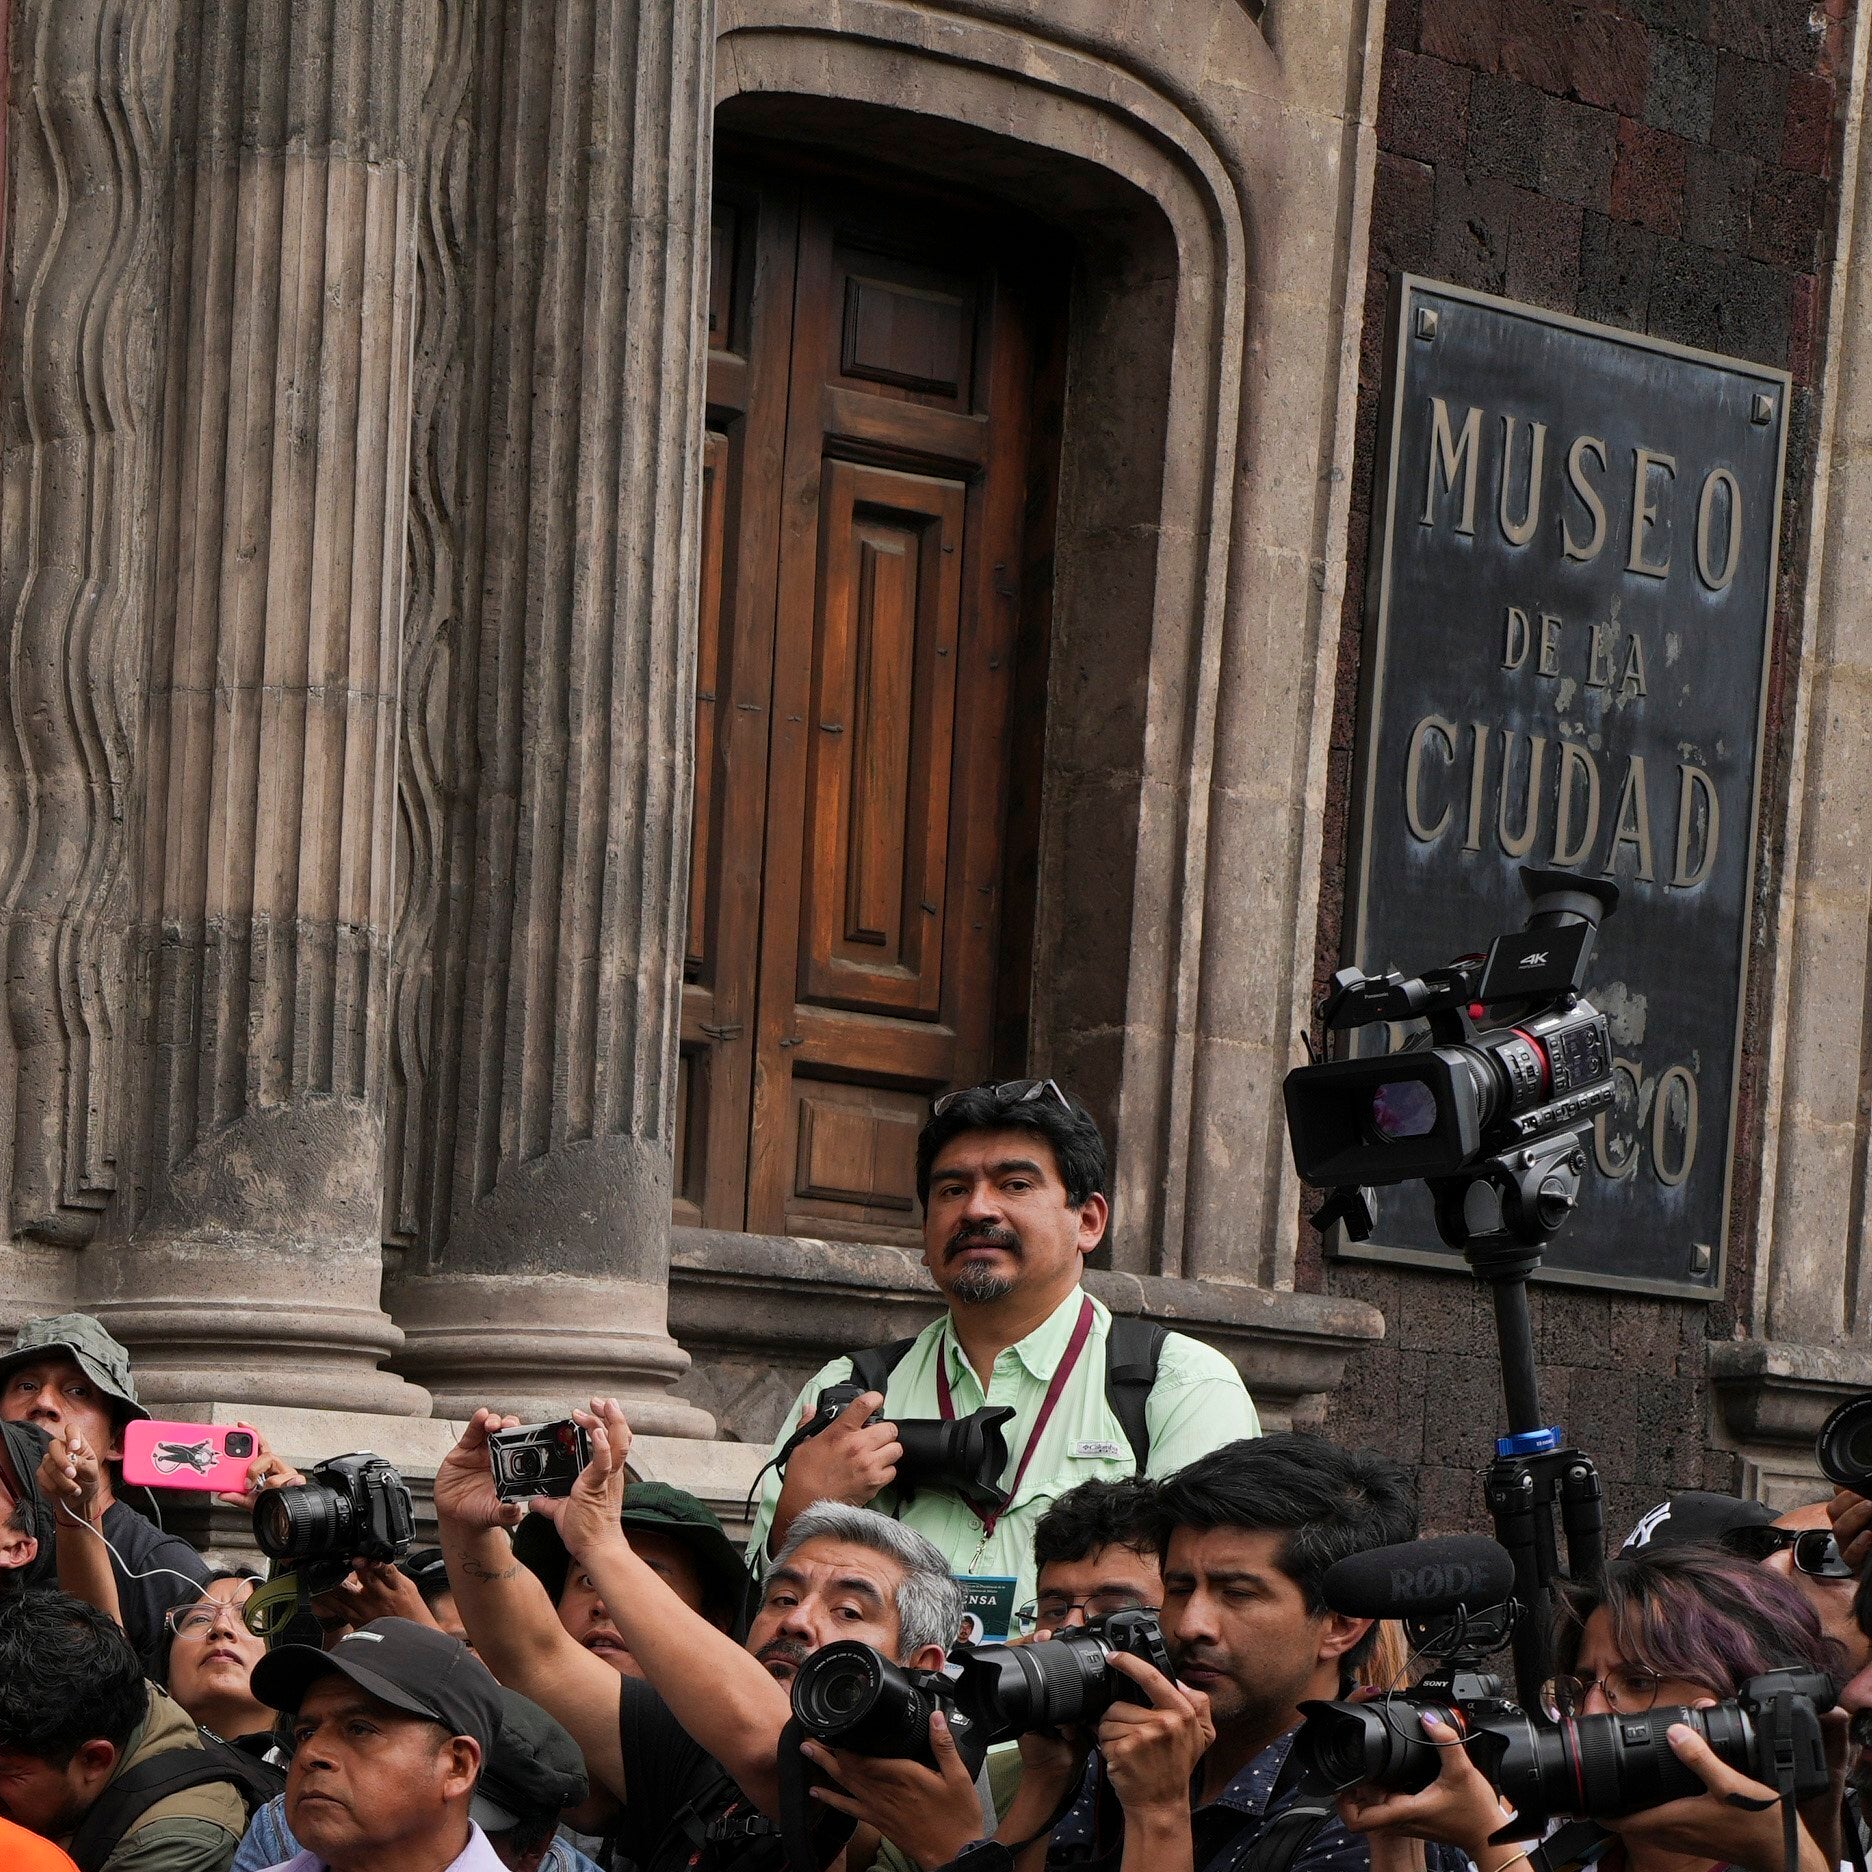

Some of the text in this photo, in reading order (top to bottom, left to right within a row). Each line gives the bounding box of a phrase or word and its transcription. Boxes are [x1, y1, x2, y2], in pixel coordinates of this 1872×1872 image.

[1419, 395, 1744, 592] MUSEO
[1501, 605, 1648, 697] DE LA
[1404, 713, 1720, 889] CIUDAD
[1520, 952, 1549, 965] 4K
